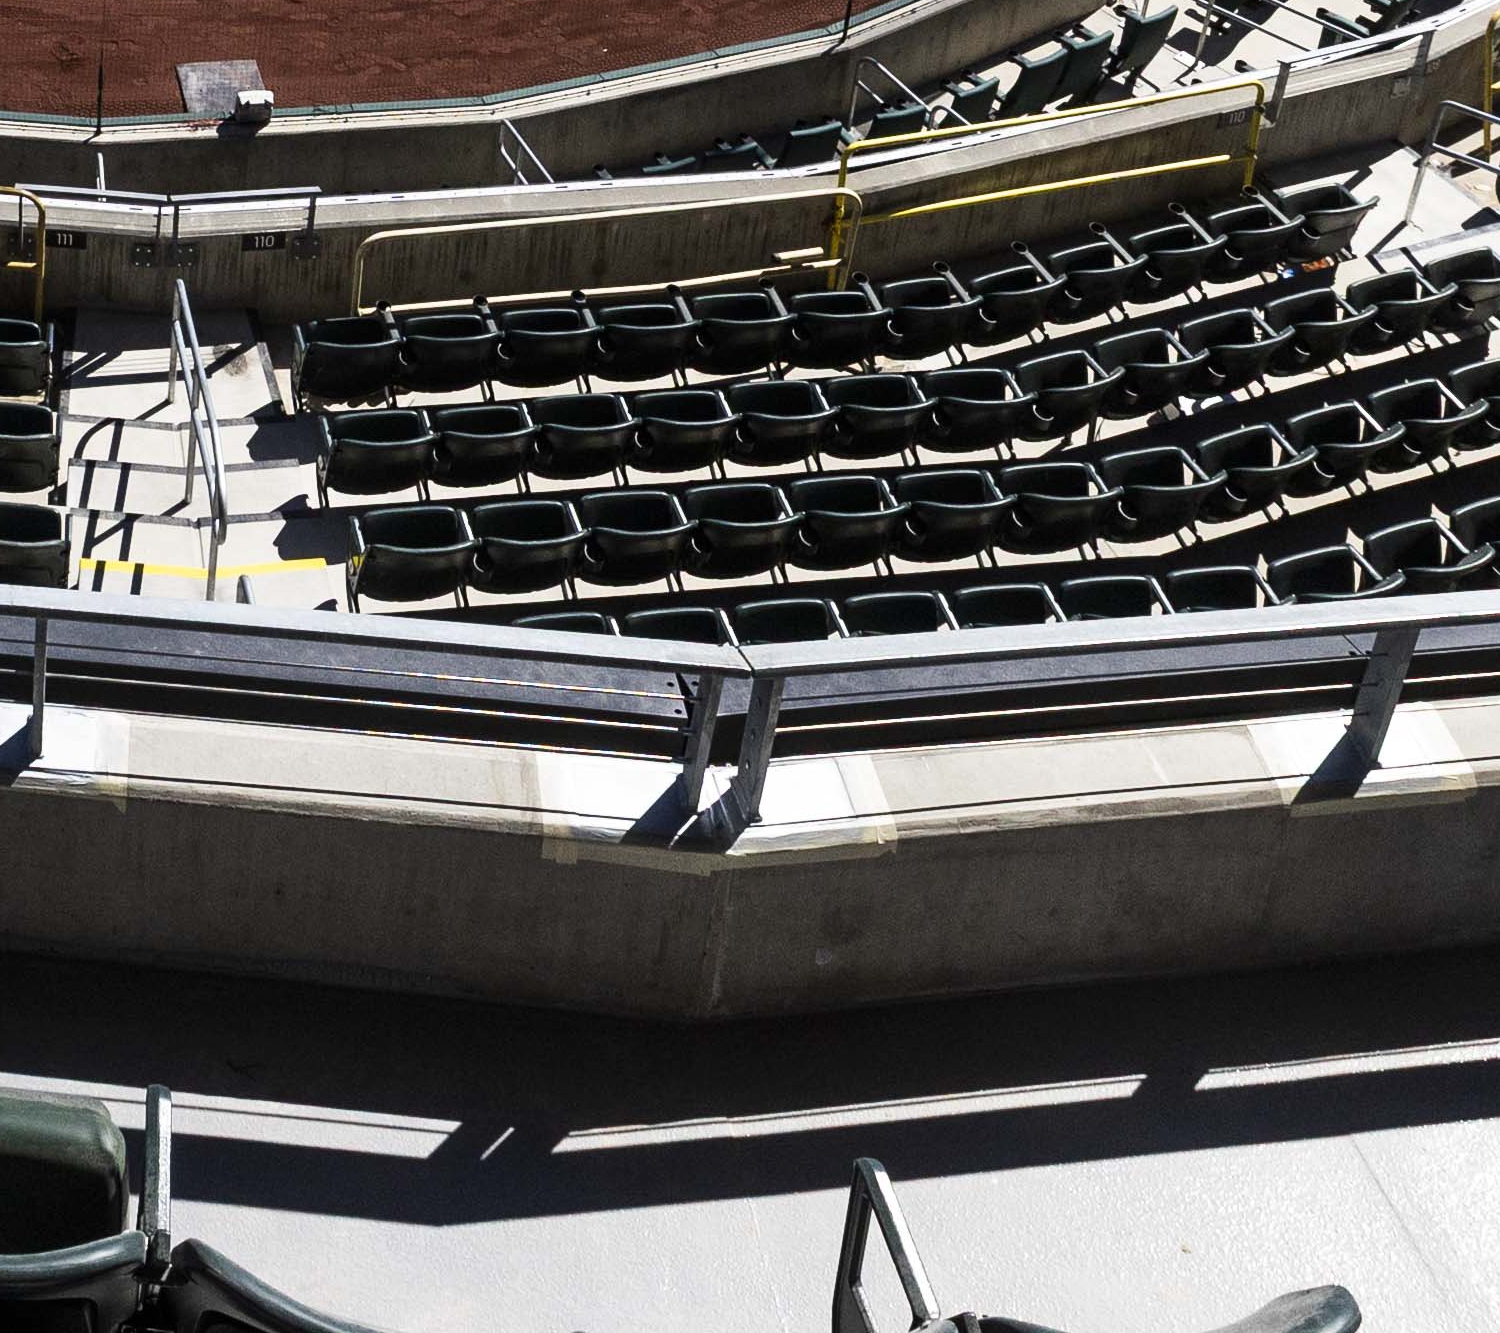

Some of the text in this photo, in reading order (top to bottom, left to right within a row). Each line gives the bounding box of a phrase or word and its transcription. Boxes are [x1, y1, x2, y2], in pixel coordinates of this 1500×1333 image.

[1229, 110, 1246, 125] 110
[57, 233, 73, 246] 111
[254, 235, 275, 249] 110
